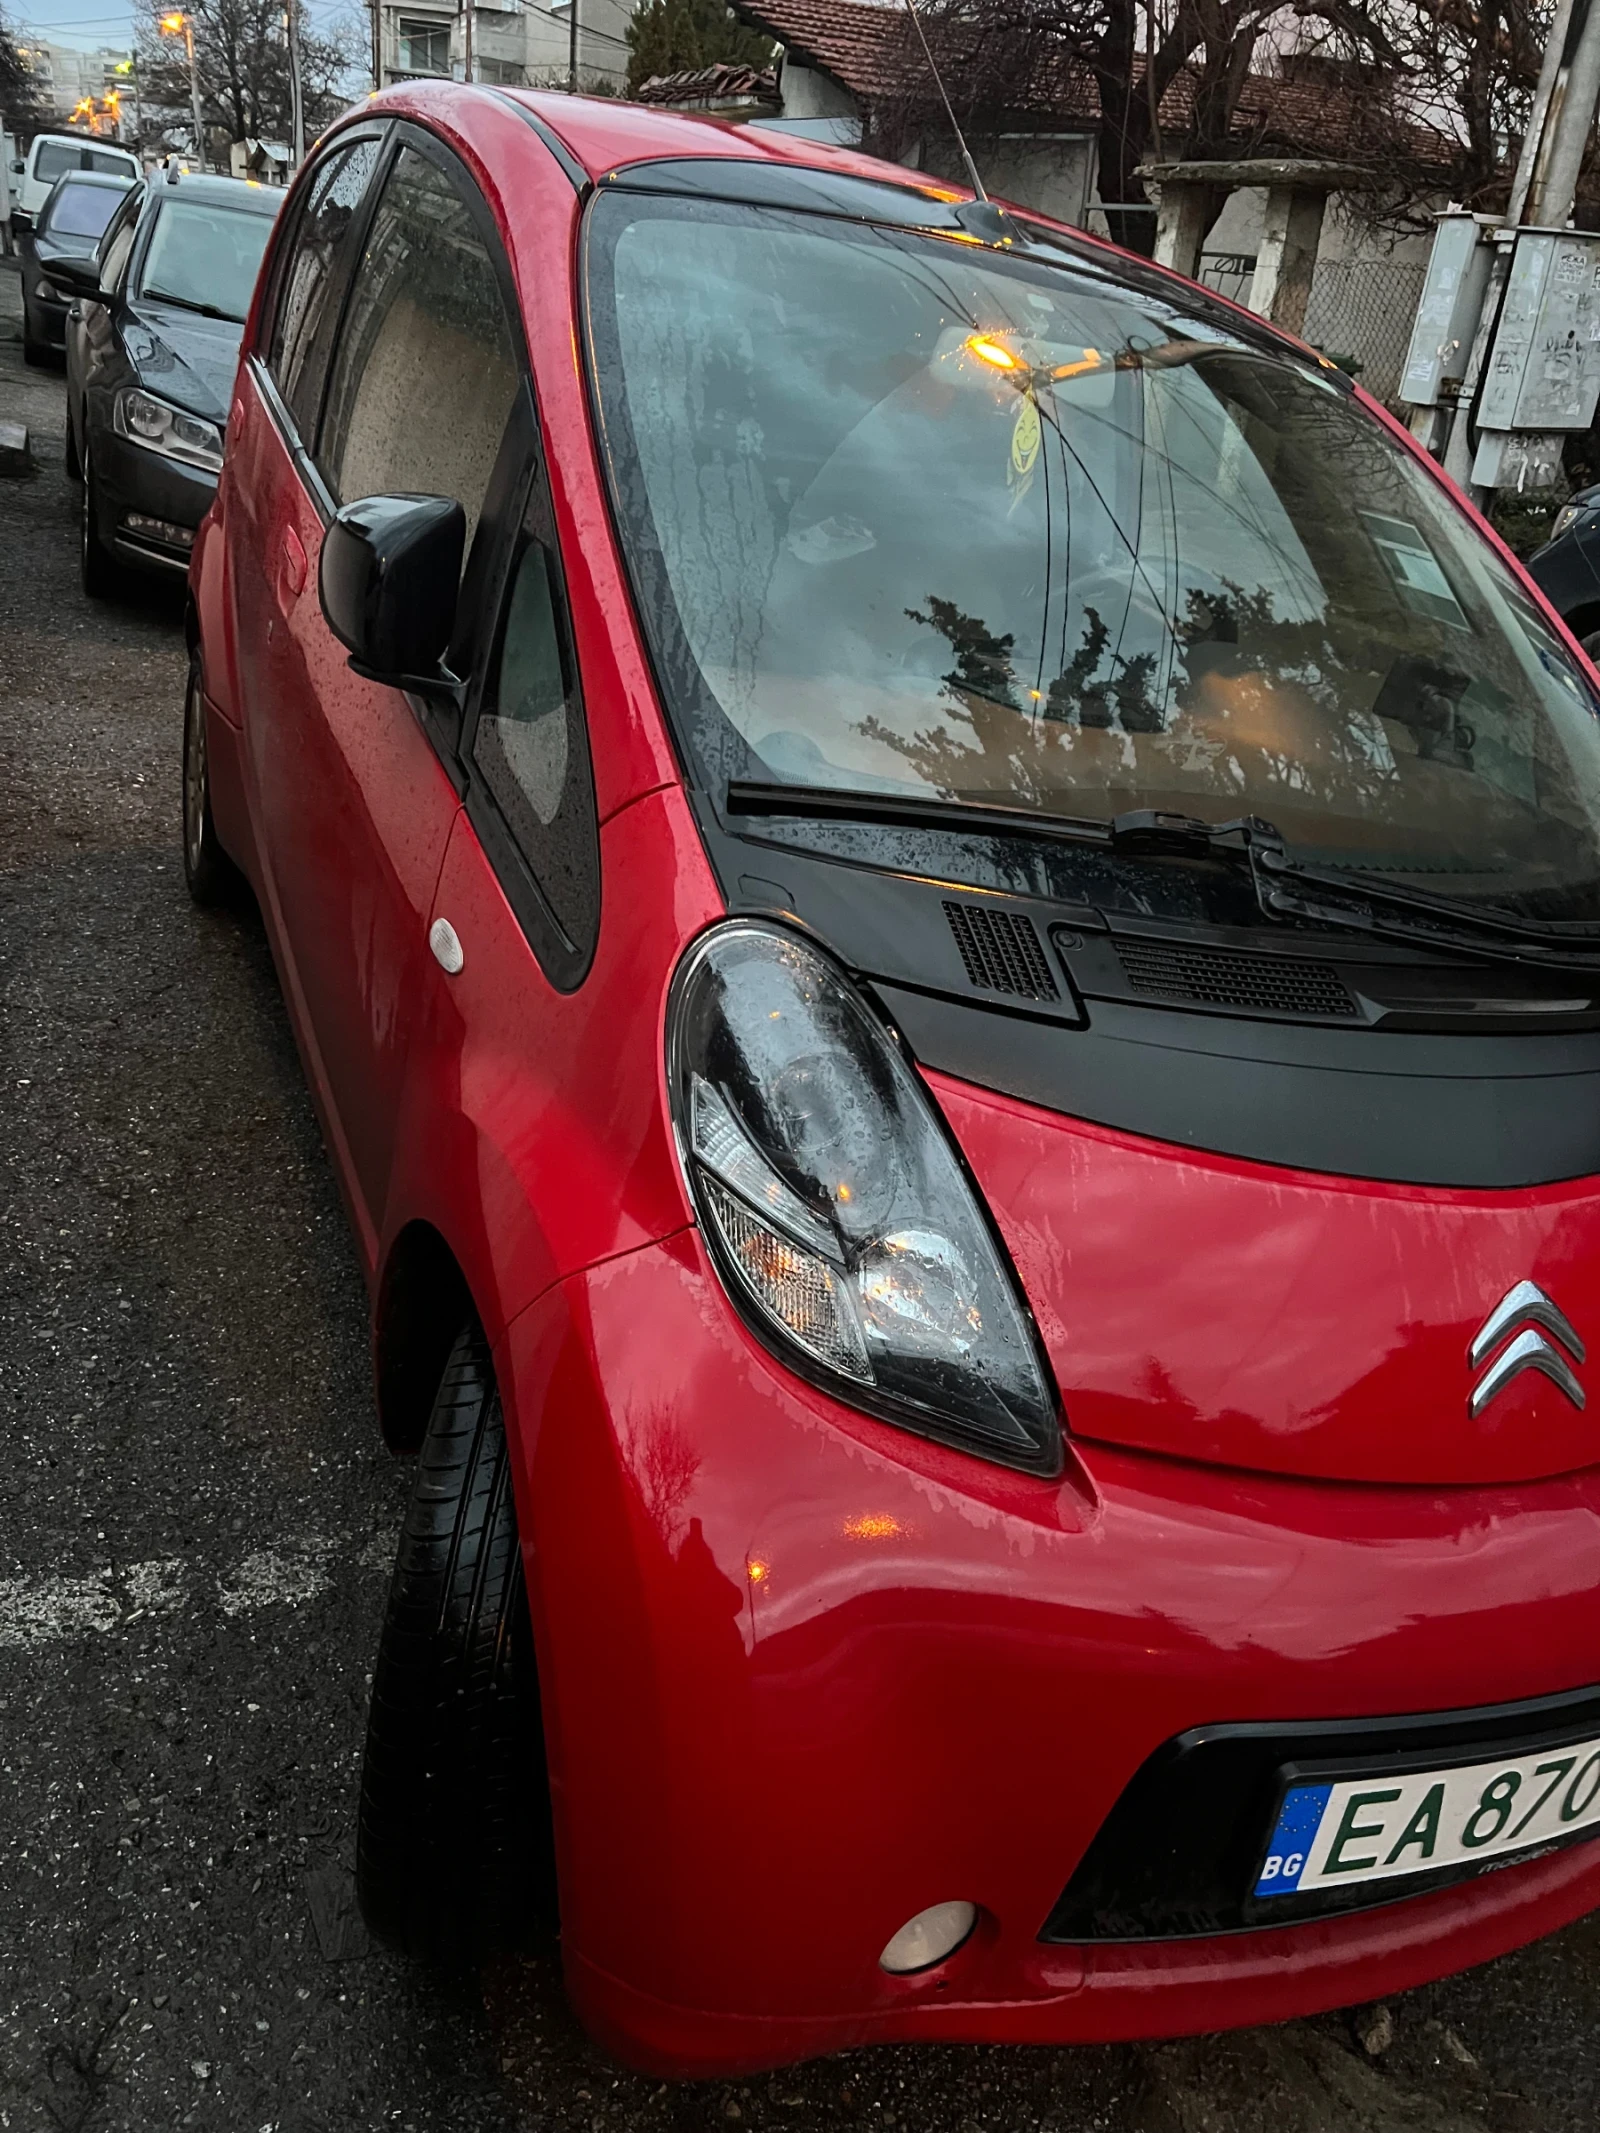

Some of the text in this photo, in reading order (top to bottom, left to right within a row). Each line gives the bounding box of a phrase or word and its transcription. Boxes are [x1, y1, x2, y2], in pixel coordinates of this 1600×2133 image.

[1321, 1750, 1600, 1876] EA 870
[1260, 1853, 1303, 1881] BG
